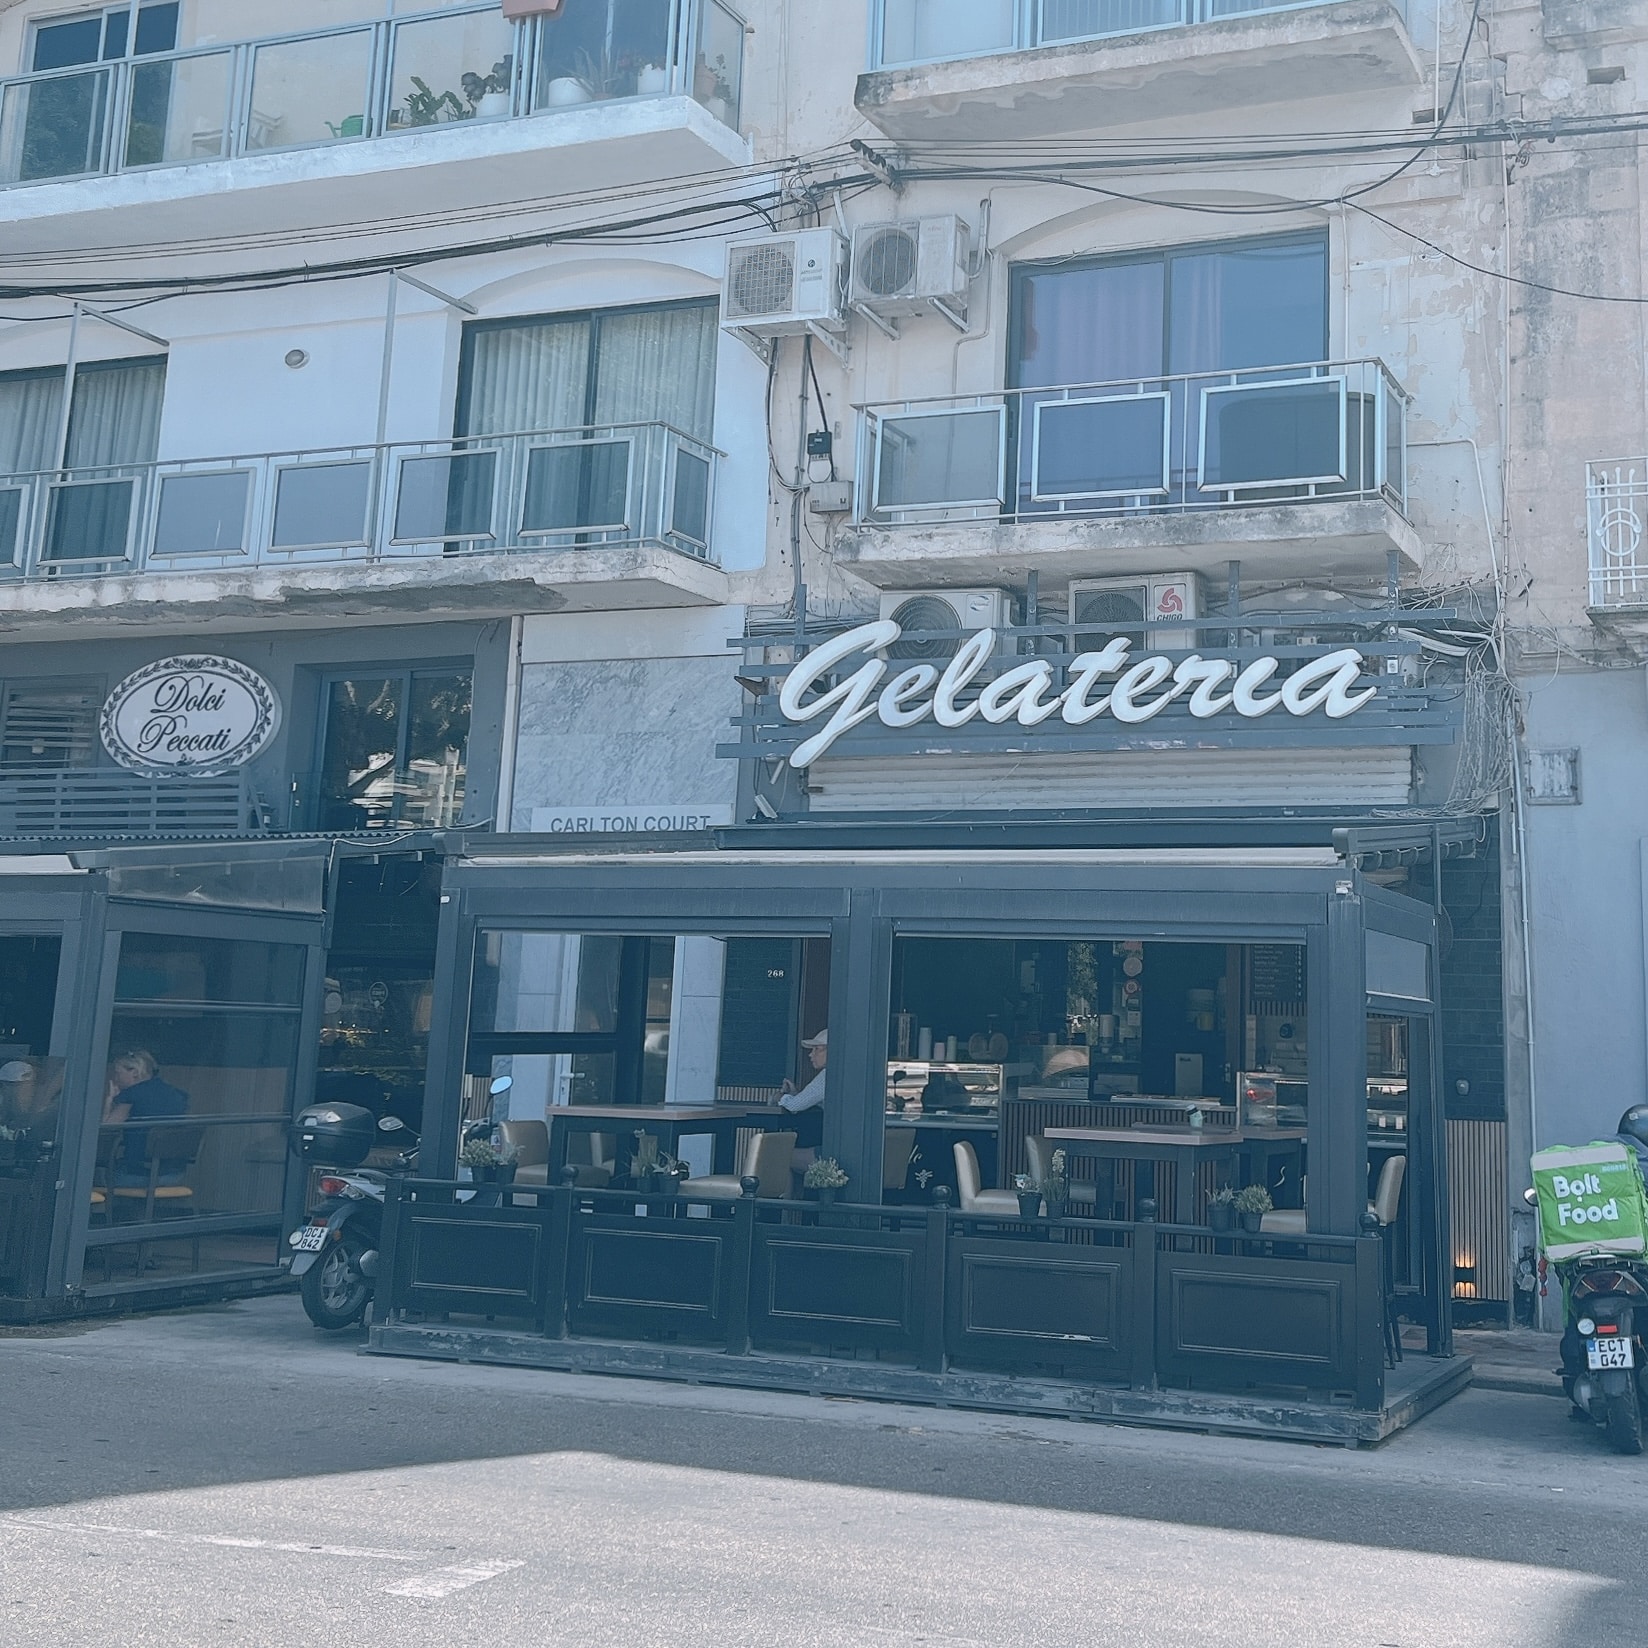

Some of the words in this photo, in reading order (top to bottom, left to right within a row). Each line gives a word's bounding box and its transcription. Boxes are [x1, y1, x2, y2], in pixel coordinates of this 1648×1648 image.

[1156, 613, 1183, 621] CHIGO
[150, 675, 226, 713] Dolci
[779, 619, 1378, 769] Gelateria
[137, 714, 231, 753] Peccati
[643, 815, 711, 832] COURT
[767, 969, 785, 978] 268
[1552, 1172, 1602, 1199] Bolt
[1557, 1198, 1619, 1227] Food
[300, 1238, 320, 1250] 842
[1598, 1339, 1626, 1353] ECT
[1600, 1353, 1627, 1367] 047
